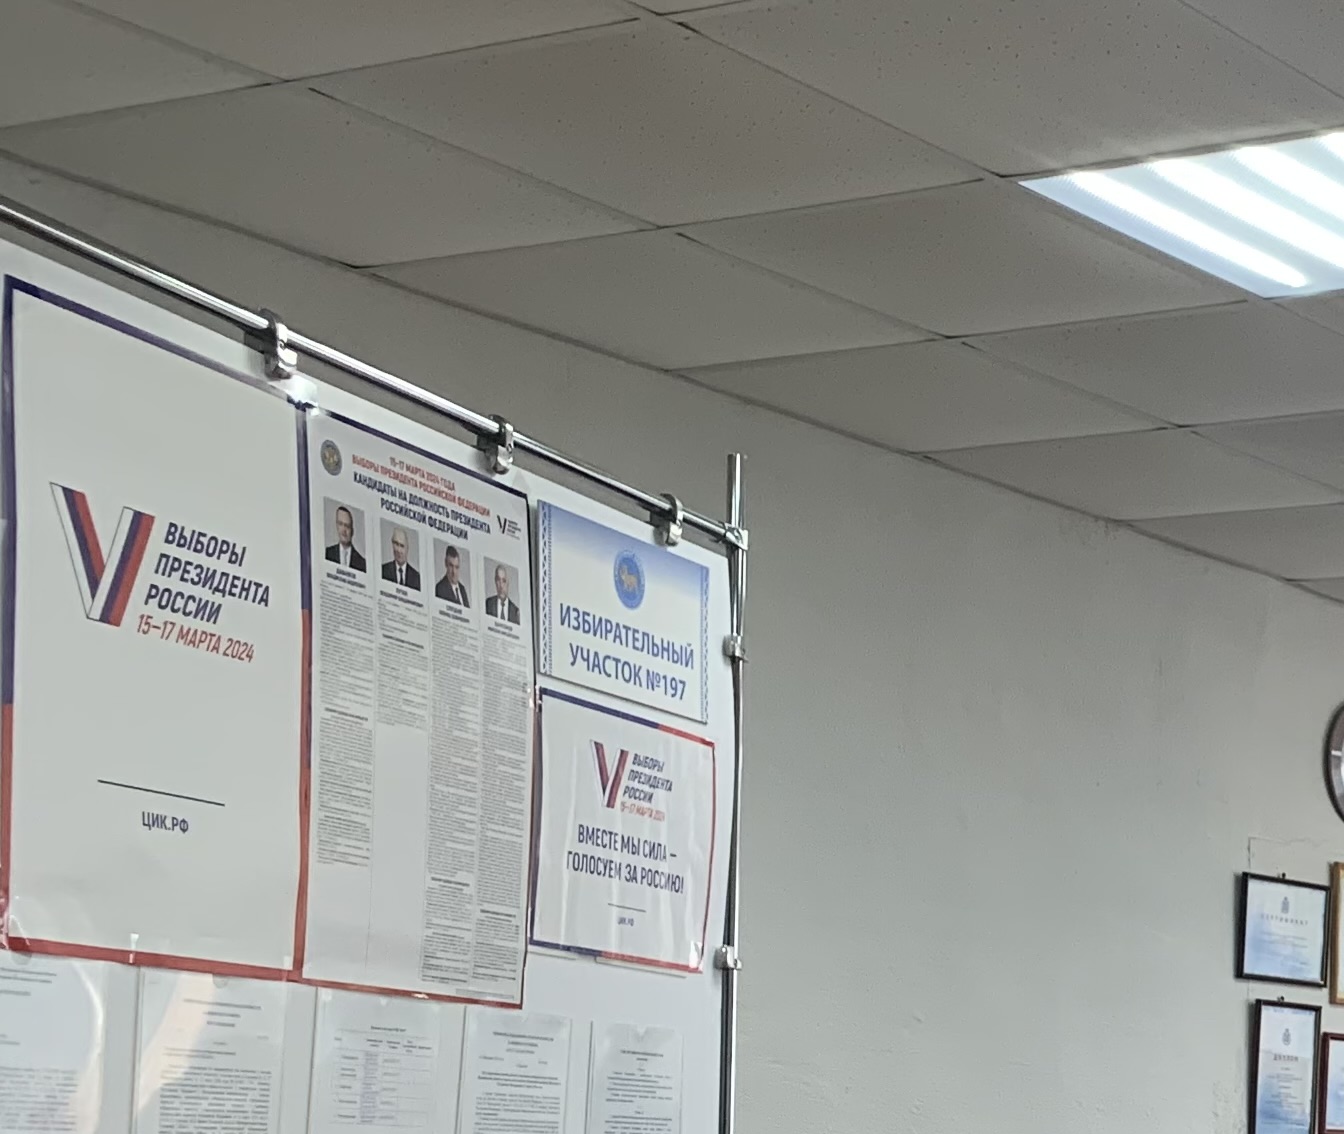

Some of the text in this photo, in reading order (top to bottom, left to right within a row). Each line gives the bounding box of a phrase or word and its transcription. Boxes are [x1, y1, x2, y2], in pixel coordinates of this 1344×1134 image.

[352, 454, 380, 473] ВЫБОРЫ
[380, 465, 418, 488] ПРЕЗИДЕНТА
[457, 496, 490, 517] ФЕДЕРАЦИИ
[353, 471, 397, 498] КАНДИДАТЫ
[398, 488, 408, 502] НА
[408, 493, 450, 519] ДОЛЖНОСТЬ
[450, 509, 491, 534] ПРЕЗИДЕНТА
[380, 497, 427, 525] РОССИЙСКОЙ
[428, 515, 469, 540] ФЕДЕРАЦИИ
[164, 521, 247, 567] ВЫБОРЫ
[154, 552, 270, 607] ПРЕЗИДЕНТА
[144, 584, 223, 625] РОССИИ
[175, 624, 222, 655] МАРТА
[222, 637, 255, 663] 2024
[559, 602, 694, 670] ИЗБИРАТЕЛЬНЫЙ
[569, 642, 687, 701] УЧАСТОК №197
[628, 769, 673, 792] ПРЕЗИДЕНТА
[632, 753, 665, 772] ВЫБОРЫ
[623, 785, 654, 804] РОССИИ
[142, 811, 189, 834] ЦИК.РФ
[578, 824, 618, 851] ВМЕСТЕ
[620, 835, 641, 858] МЫ
[642, 839, 667, 862] СИЛА
[566, 850, 685, 894] ГОЛОСУЕМ ЗА РОССИЮ!
